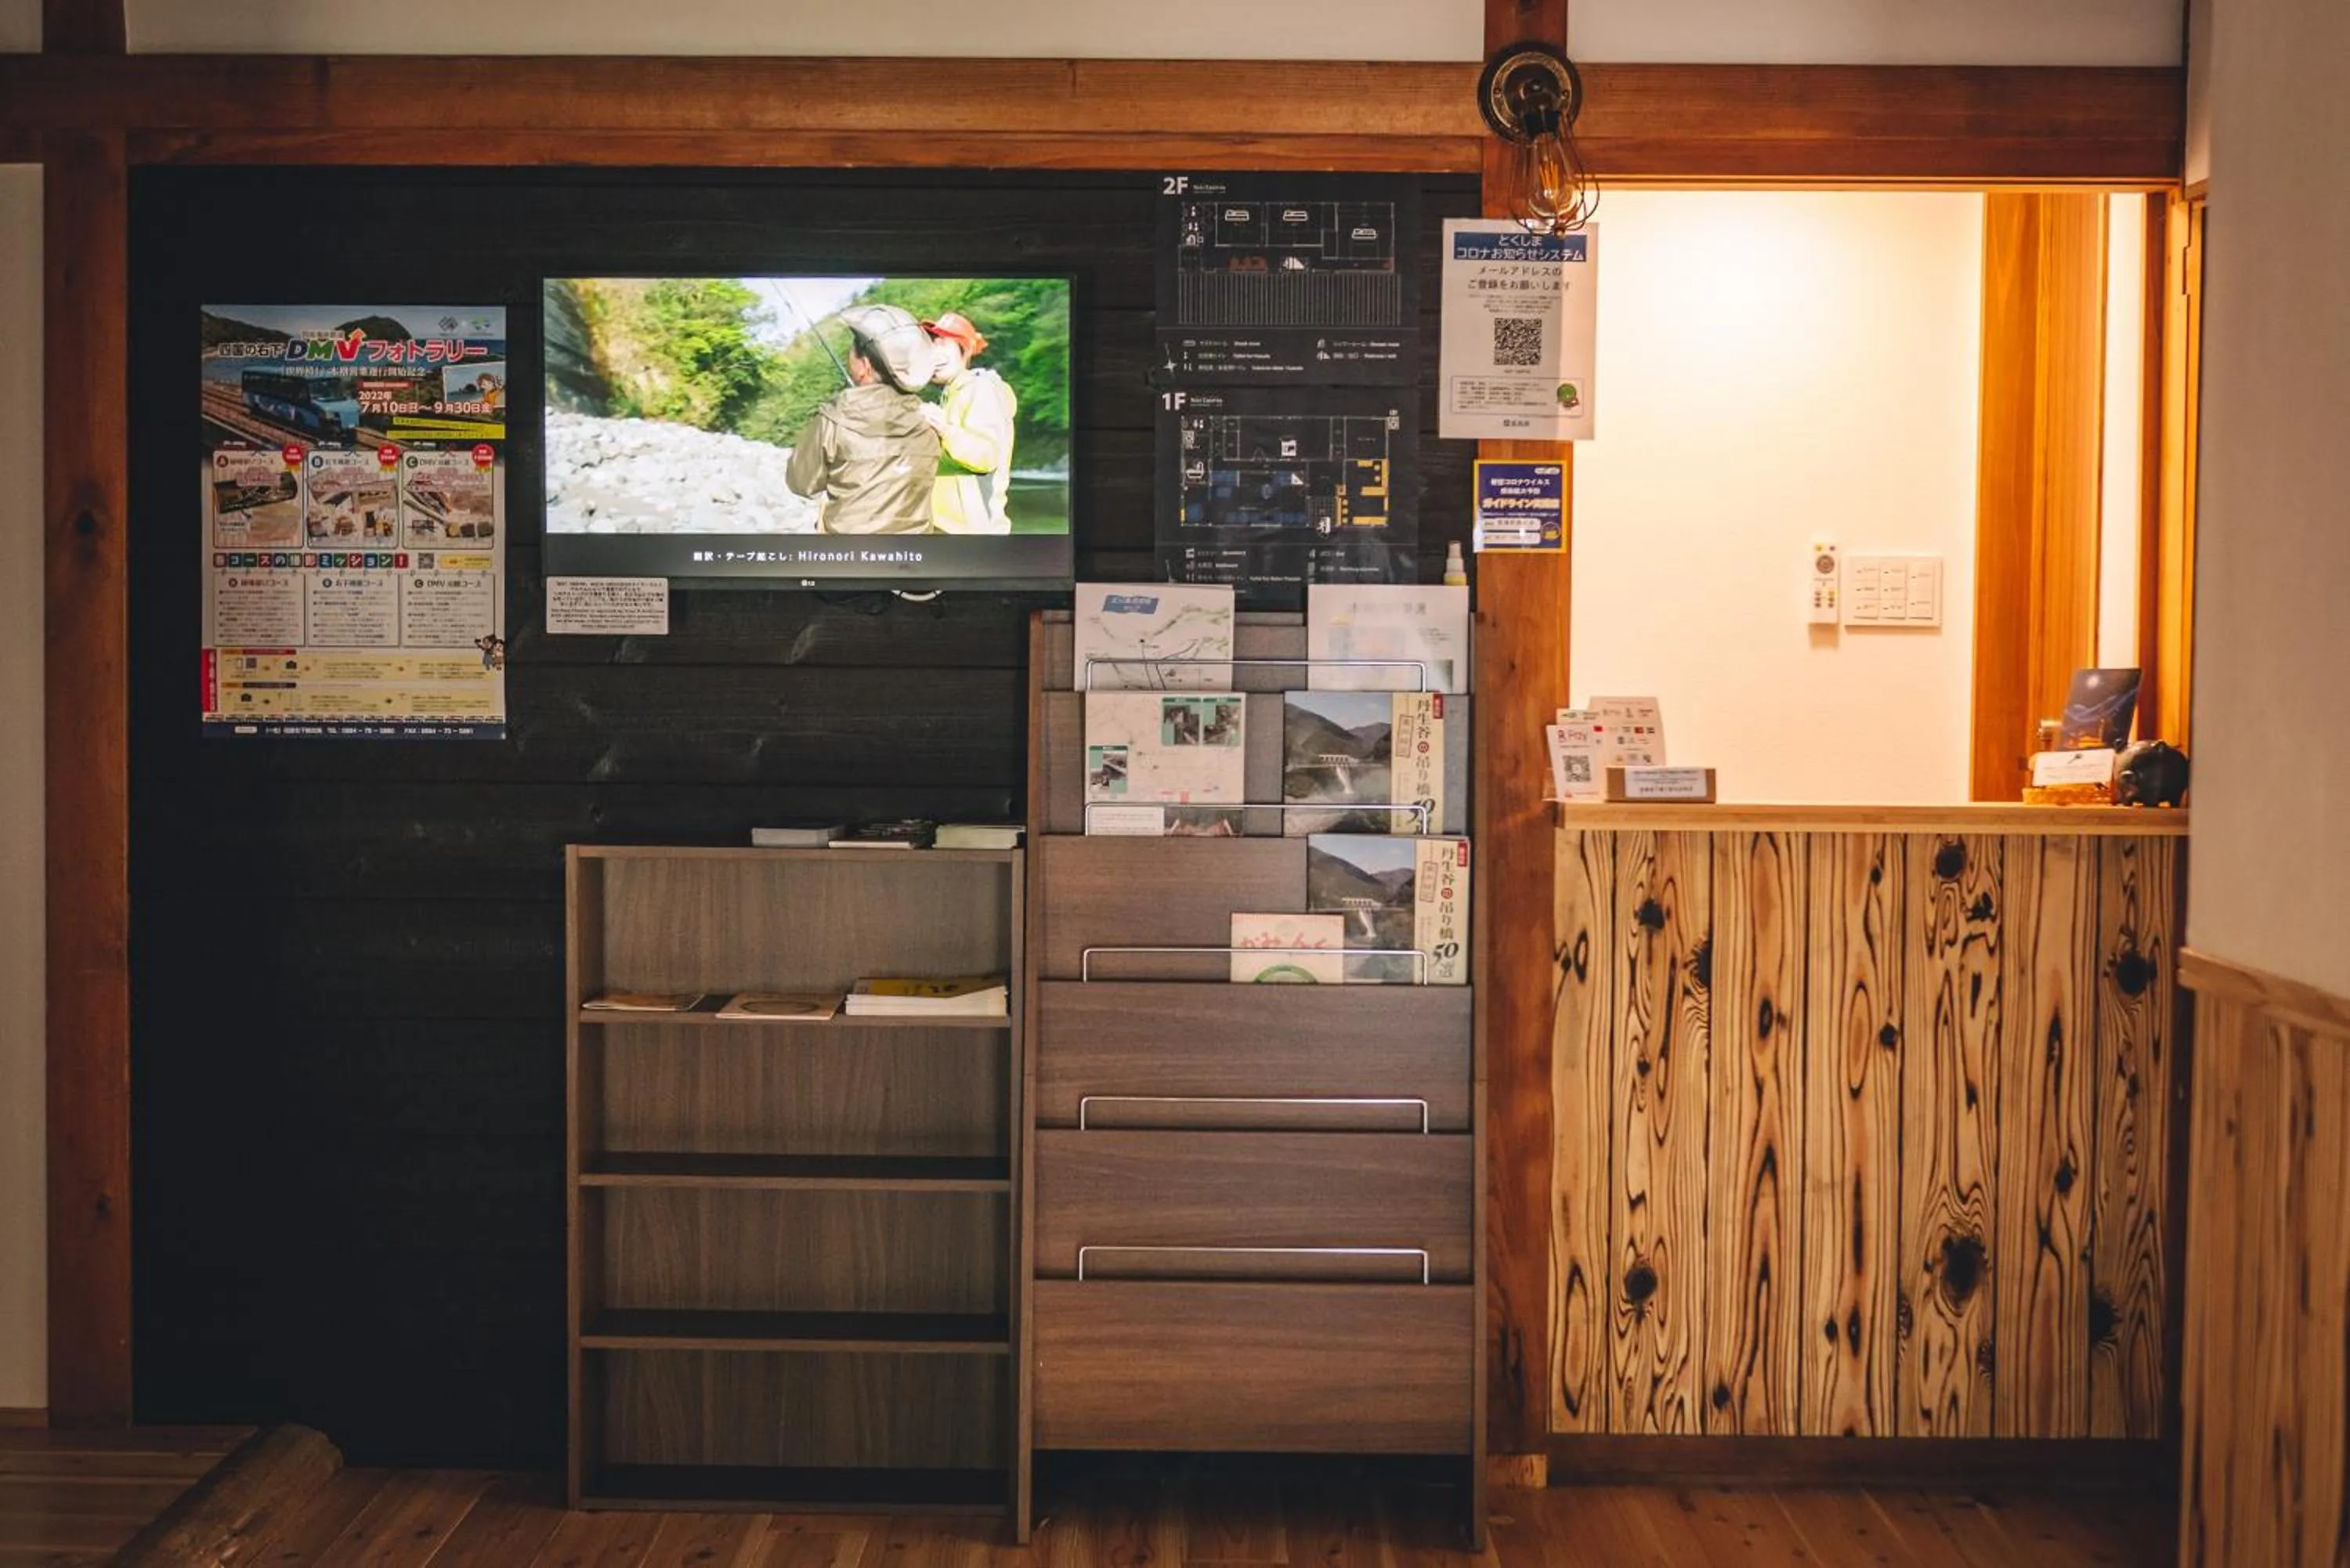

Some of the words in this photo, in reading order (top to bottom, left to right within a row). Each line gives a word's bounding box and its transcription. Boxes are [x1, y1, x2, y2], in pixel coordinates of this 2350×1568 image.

[1163, 177, 1188, 195] 2F
[1499, 235, 1542, 247] とくしま
[1456, 247, 1585, 261] コロナお知らせシステム
[1478, 266, 1563, 276] メールアドレスの
[367, 340, 488, 363] フォトラリー
[358, 391, 392, 400] 2022年
[1162, 392, 1186, 410] 1F
[798, 551, 855, 562] Hironori
[861, 551, 923, 562] Kawahito
